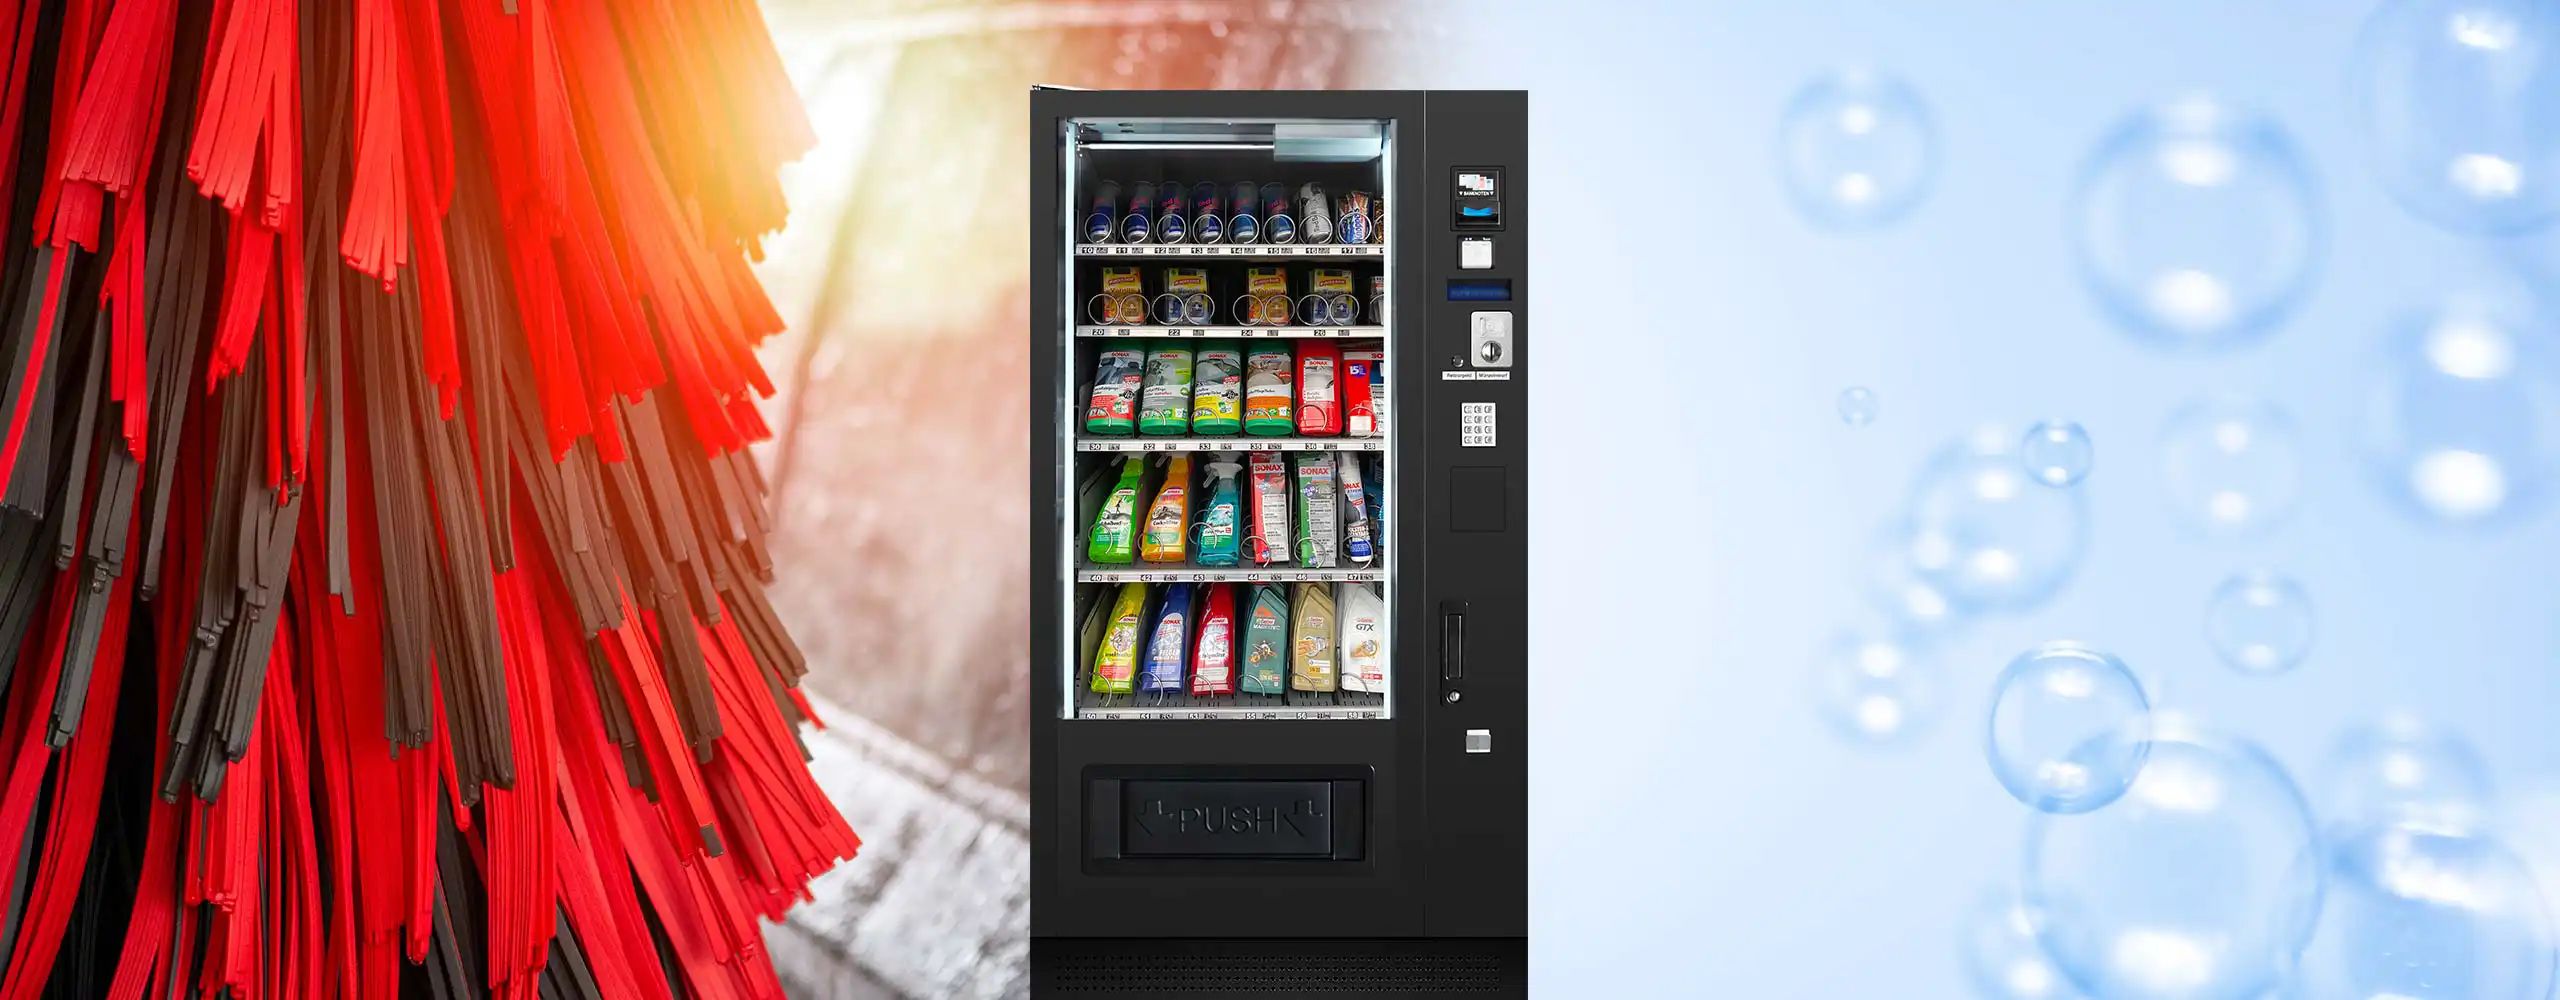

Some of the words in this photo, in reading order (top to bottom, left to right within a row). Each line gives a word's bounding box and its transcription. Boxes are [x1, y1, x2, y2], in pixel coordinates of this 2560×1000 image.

[1255, 464, 1283, 472] SONAX
[1355, 623, 1374, 631] GTX
[1179, 806, 1279, 834] PUSH
